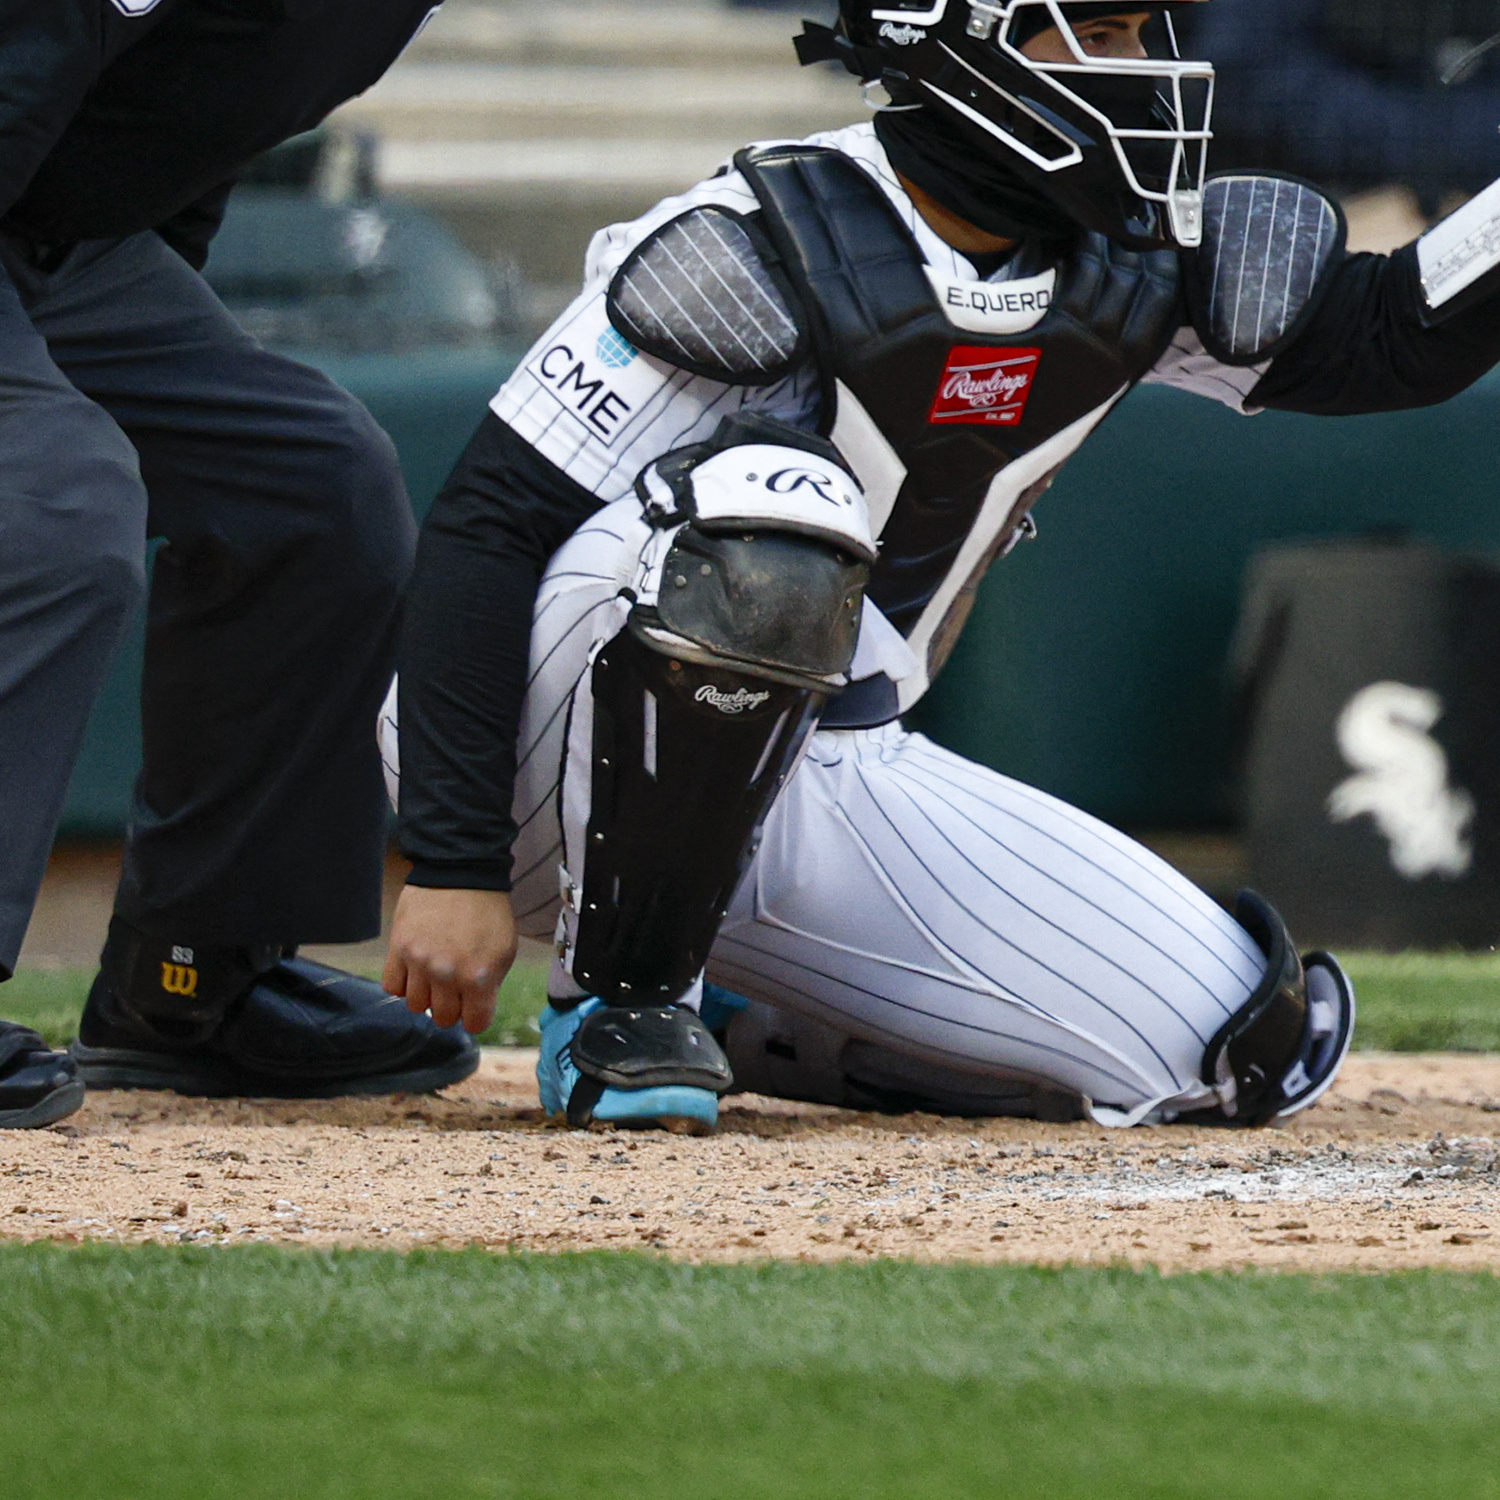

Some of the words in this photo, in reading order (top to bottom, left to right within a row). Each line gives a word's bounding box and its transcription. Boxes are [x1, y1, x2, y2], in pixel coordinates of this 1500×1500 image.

[540, 345, 632, 436] CME
[941, 367, 1029, 405] Rawlings
[694, 684, 771, 712] Rawlings
